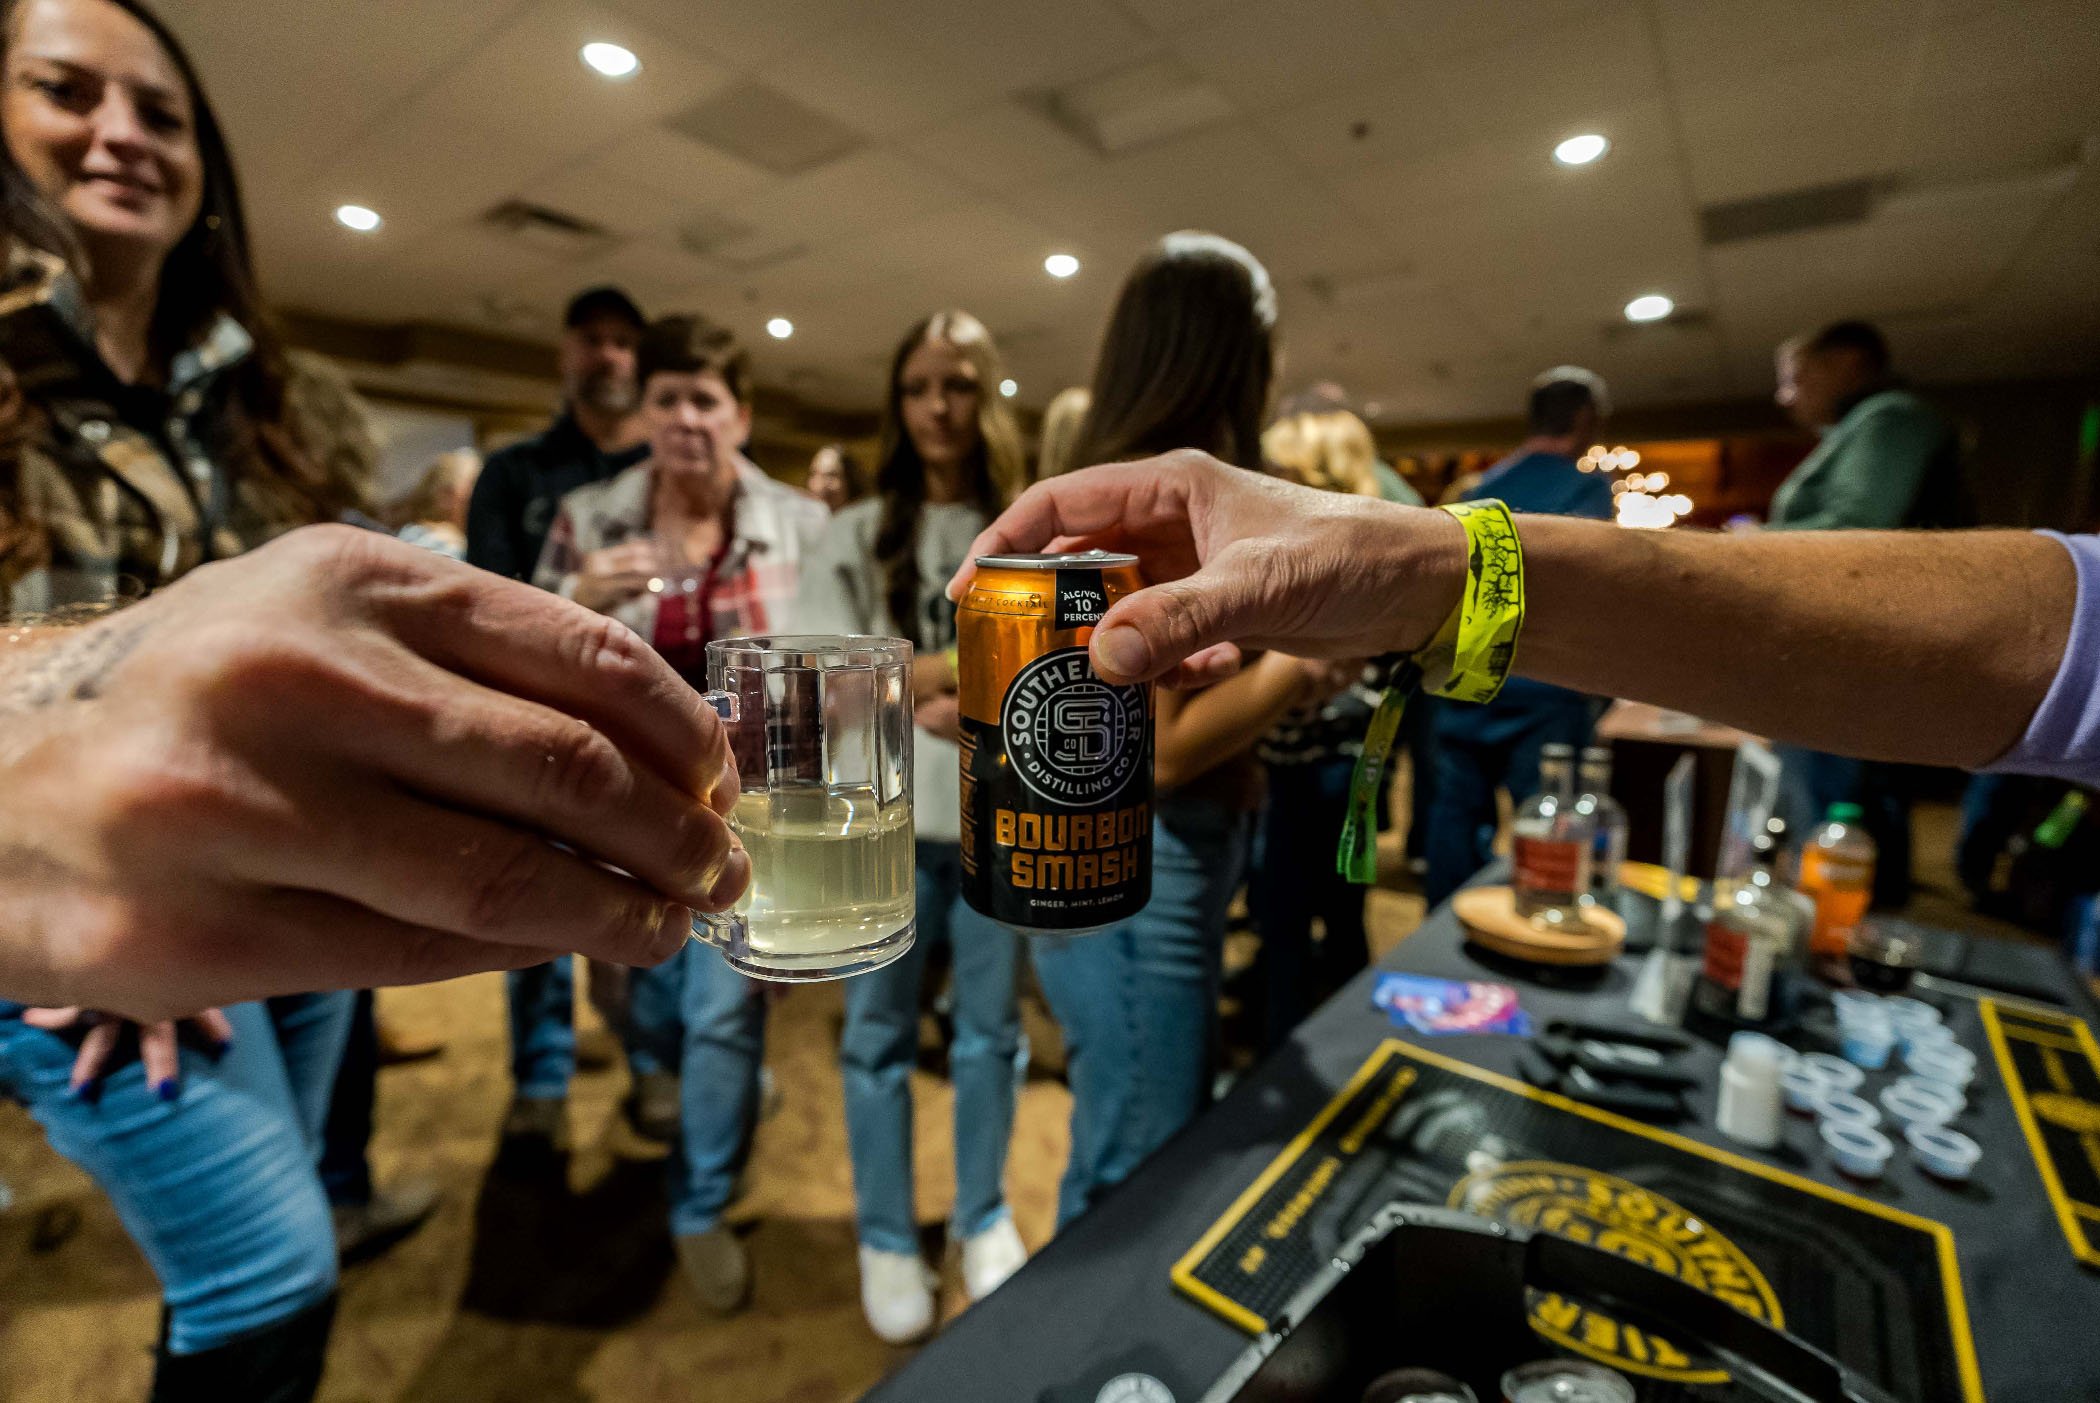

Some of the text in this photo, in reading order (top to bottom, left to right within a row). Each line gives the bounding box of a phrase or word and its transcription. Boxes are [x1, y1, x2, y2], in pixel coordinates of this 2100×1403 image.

[1063, 590, 1102, 601] ALC/VOL
[1074, 599, 1093, 613] 10
[1011, 660, 1142, 746] SOUTHE TIER
[1027, 761, 1113, 795] DISTILLING
[995, 803, 1148, 851] BOURBON
[1011, 846, 1138, 891] SMASH
[1030, 898, 1069, 909] GINGER,
[1097, 892, 1125, 905] LEMON
